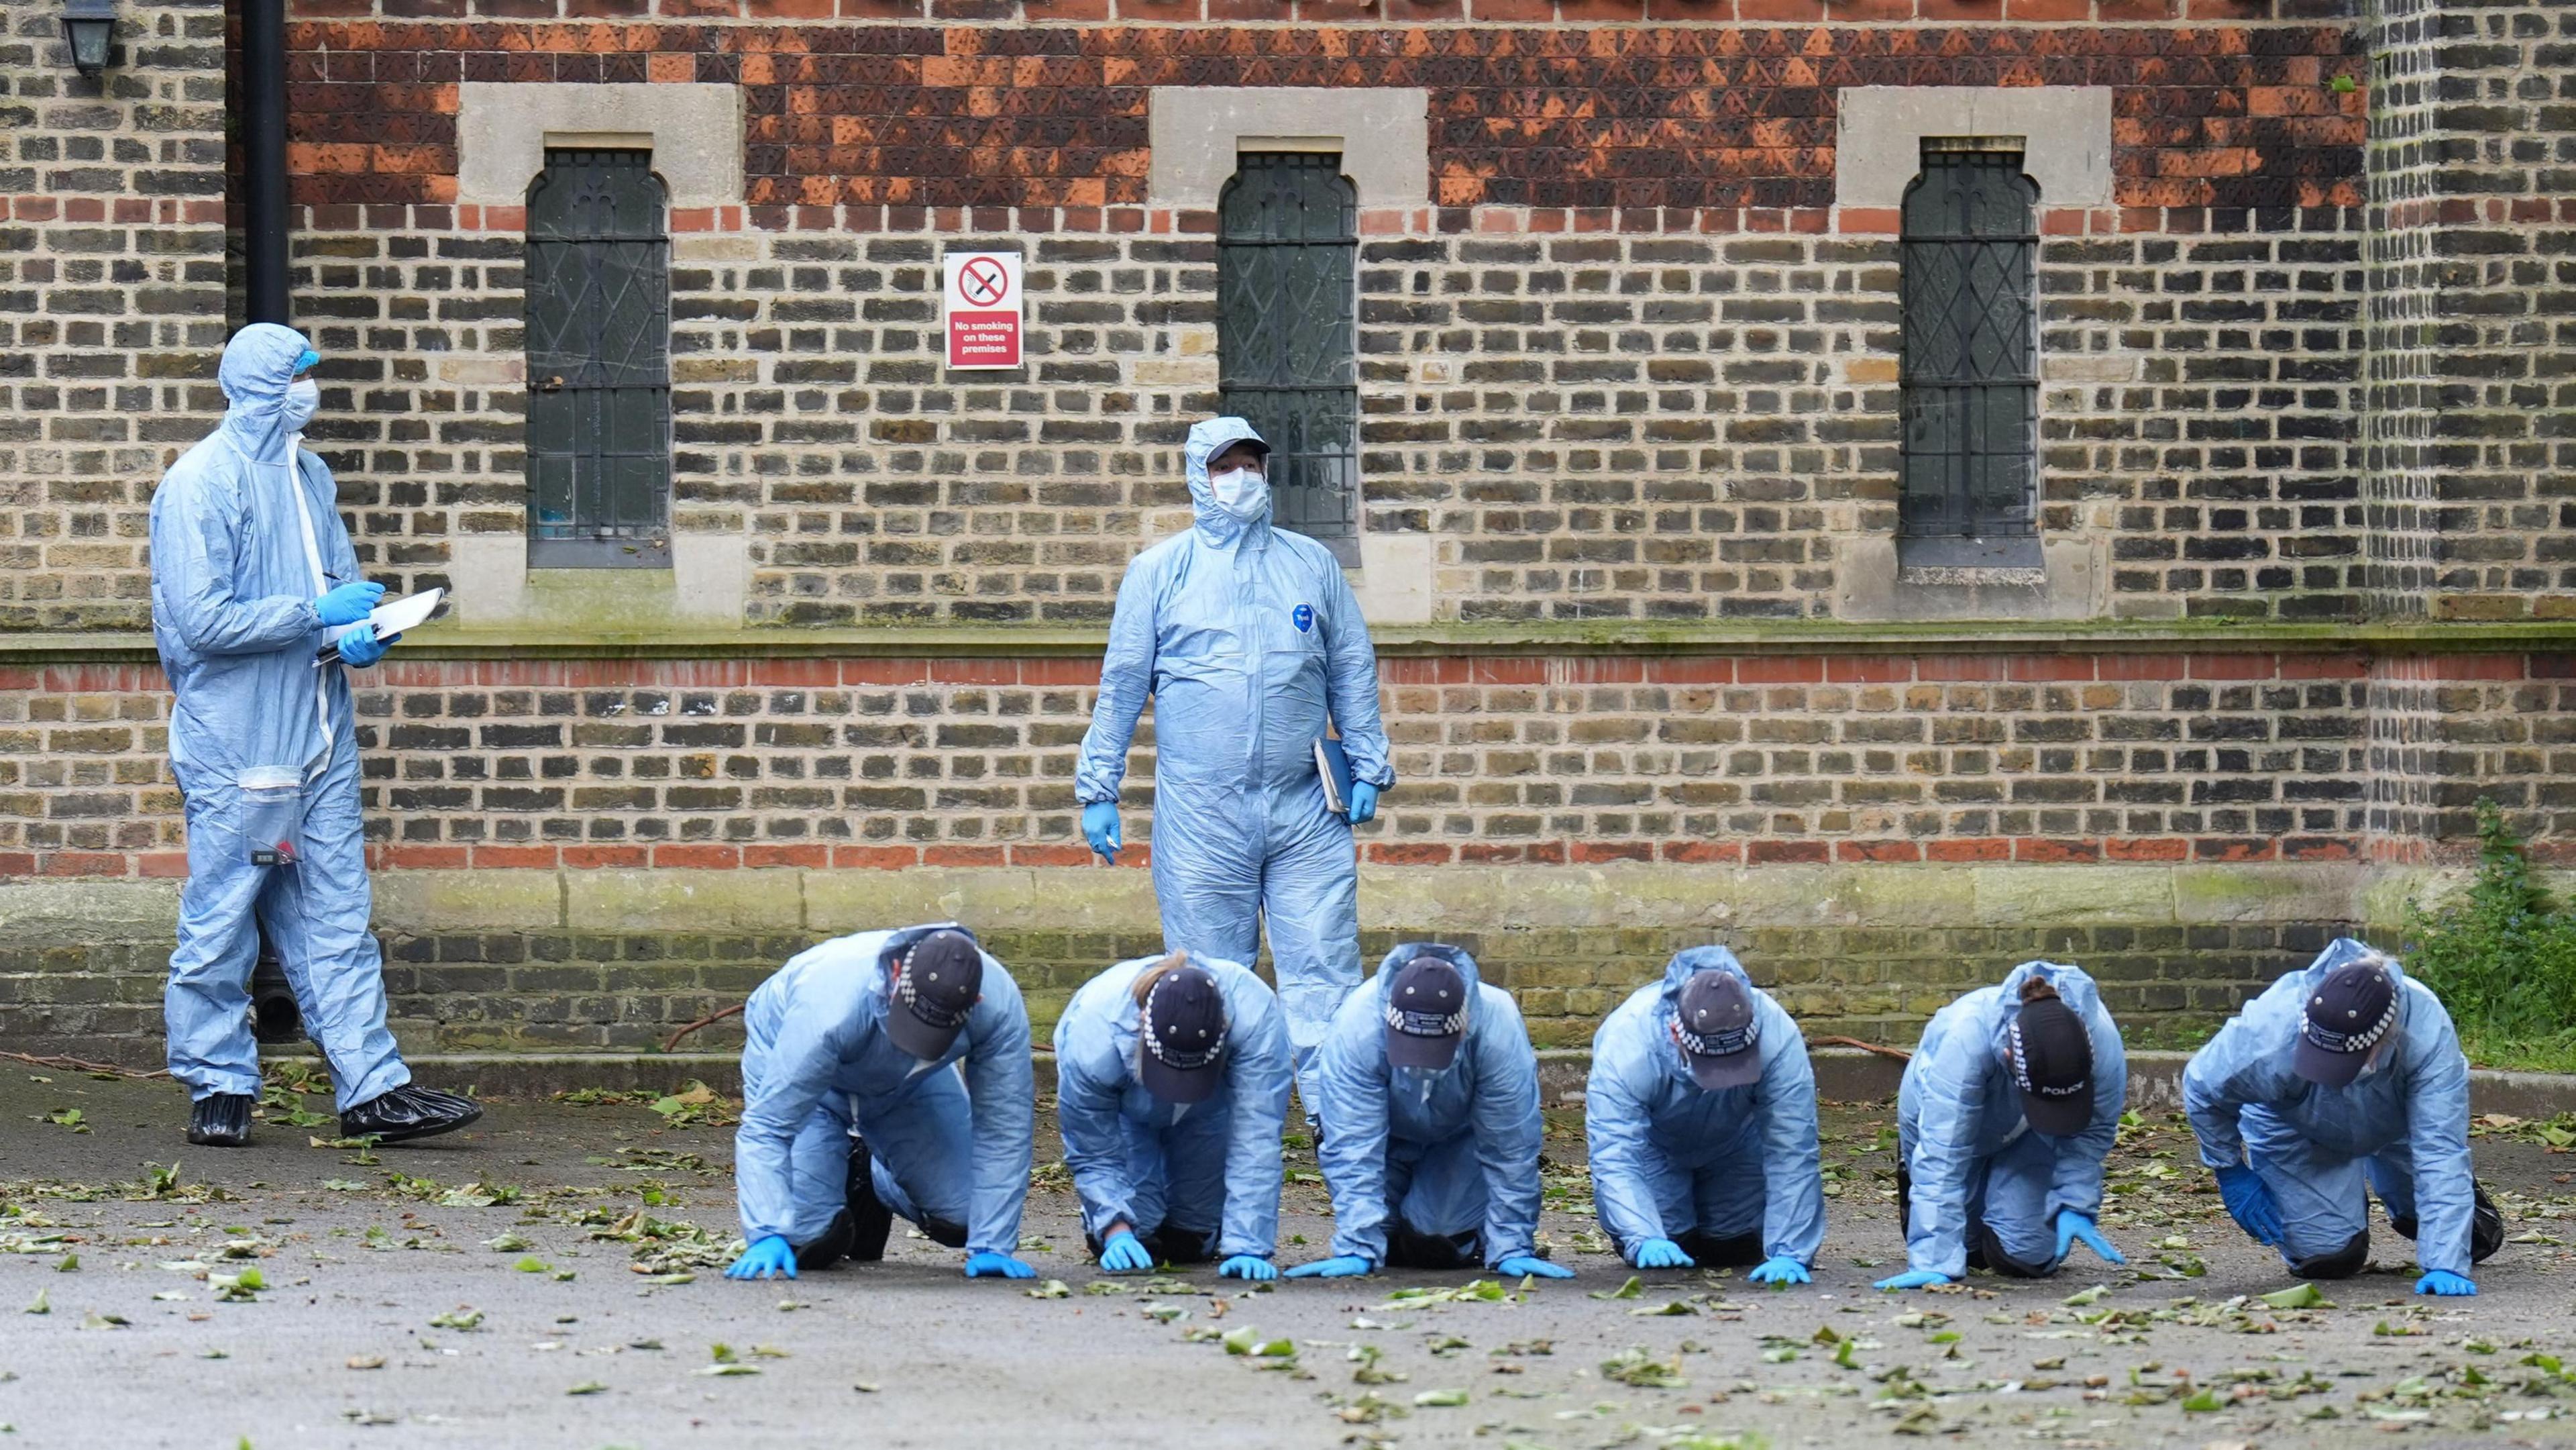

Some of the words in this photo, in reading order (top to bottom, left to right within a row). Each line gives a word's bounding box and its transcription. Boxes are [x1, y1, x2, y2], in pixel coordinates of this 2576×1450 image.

[955, 321, 969, 331] No
[971, 321, 1014, 332] smoking
[978, 333, 1005, 342] these
[962, 344, 1007, 355] premises
[2042, 1080, 2084, 1095] POLICE
